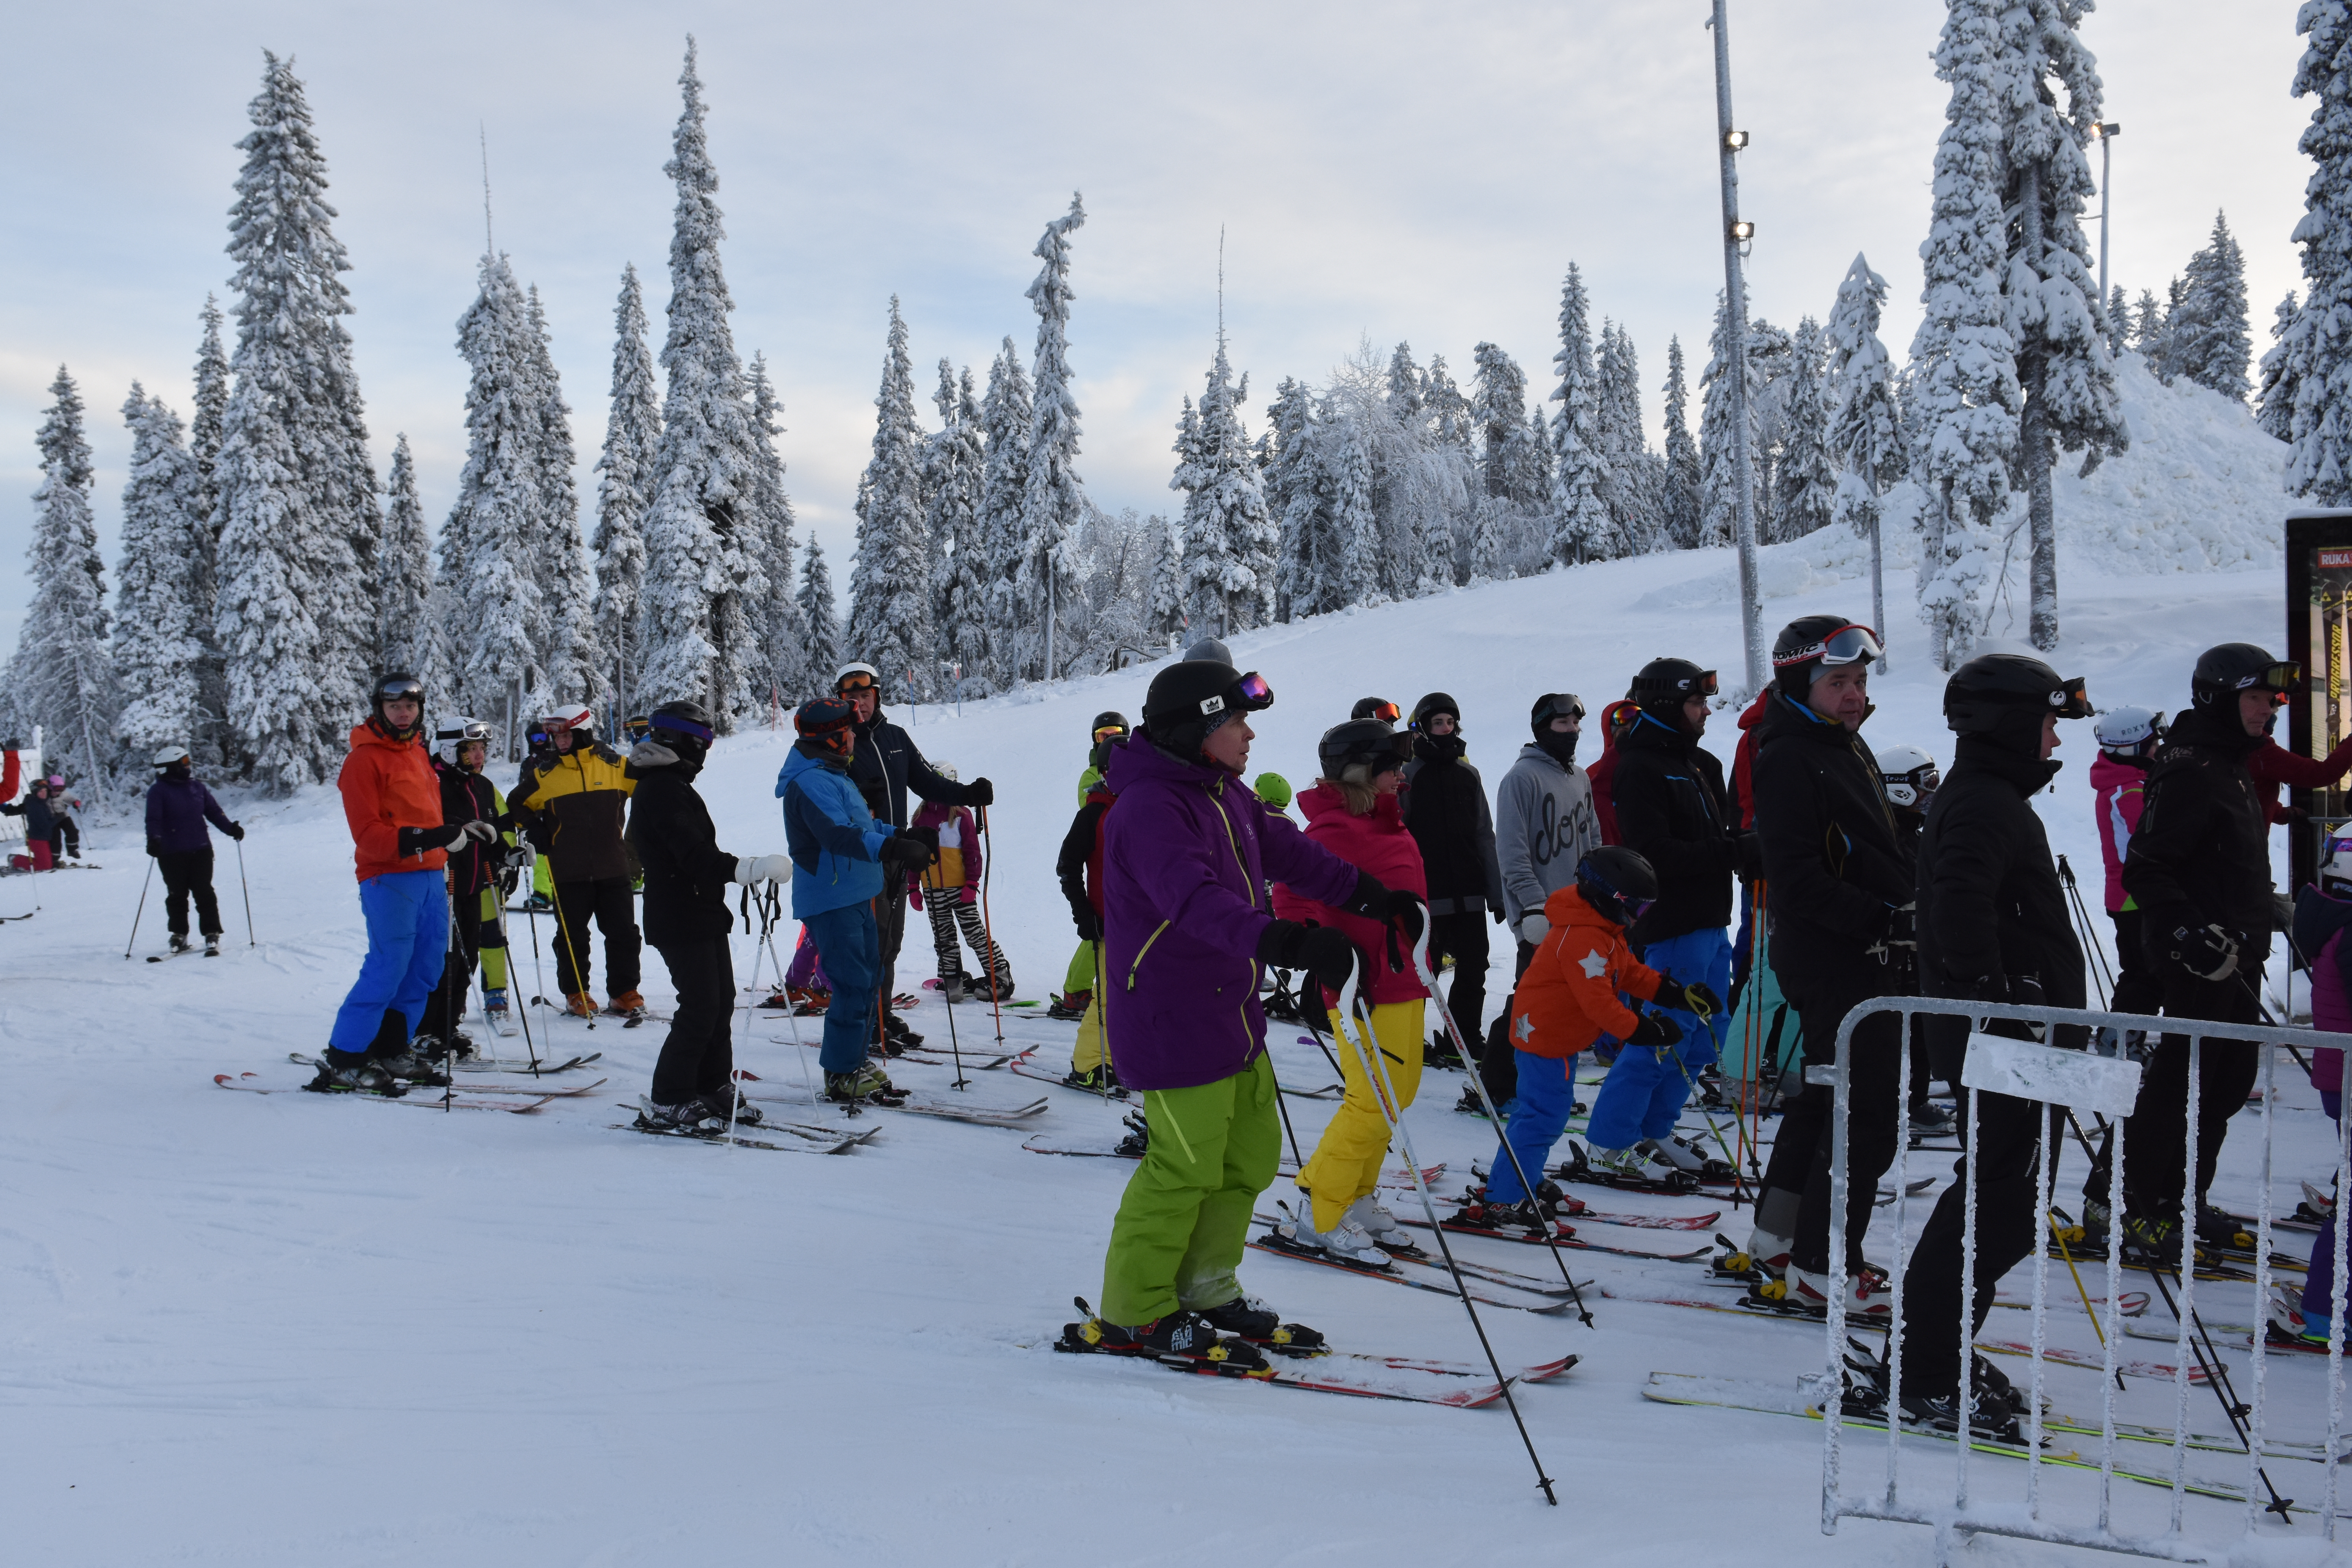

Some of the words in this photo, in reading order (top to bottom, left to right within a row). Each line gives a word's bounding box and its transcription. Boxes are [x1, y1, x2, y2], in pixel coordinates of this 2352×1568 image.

[2330, 624, 2342, 701] PROGRESSOR
[812, 716, 849, 732] SMITH
[1206, 713, 1228, 734] EDGE
[2122, 724, 2144, 736] ROXY
[1535, 792, 1592, 866] dope
[1443, 1010, 1464, 1051] ATOMIC
[1590, 1158, 1637, 1175] HEAD
